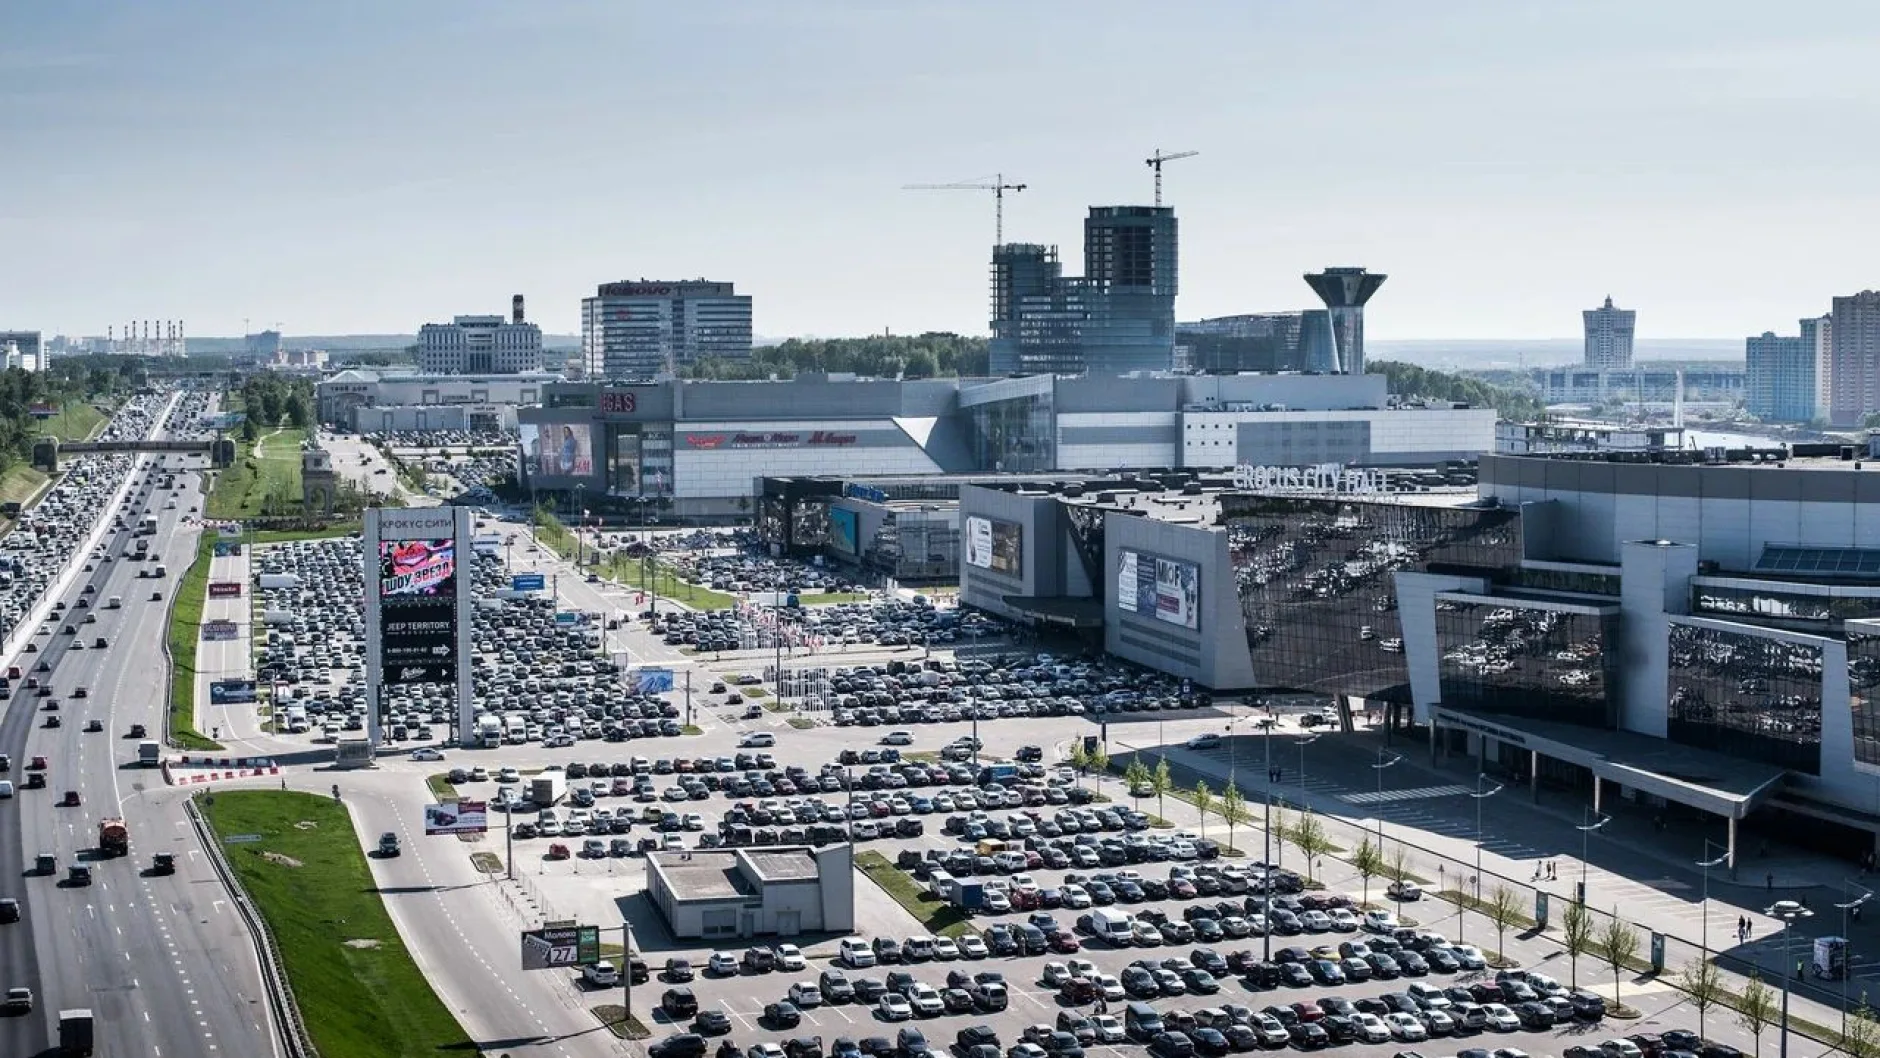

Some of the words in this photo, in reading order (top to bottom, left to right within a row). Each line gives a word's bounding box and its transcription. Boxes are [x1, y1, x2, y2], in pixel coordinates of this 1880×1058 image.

[1232, 463, 1300, 489] CROCUS
[1303, 463, 1341, 494] CITY
[1345, 467, 1395, 496] HALL
[381, 520, 424, 529] КРОКУС
[425, 519, 452, 528] СИТИ
[382, 573, 412, 594] ШОУ
[386, 622, 406, 631] JEEP
[407, 621, 450, 630] TERRITORY
[544, 930, 577, 940] Молоко
[553, 947, 571, 961] 27
